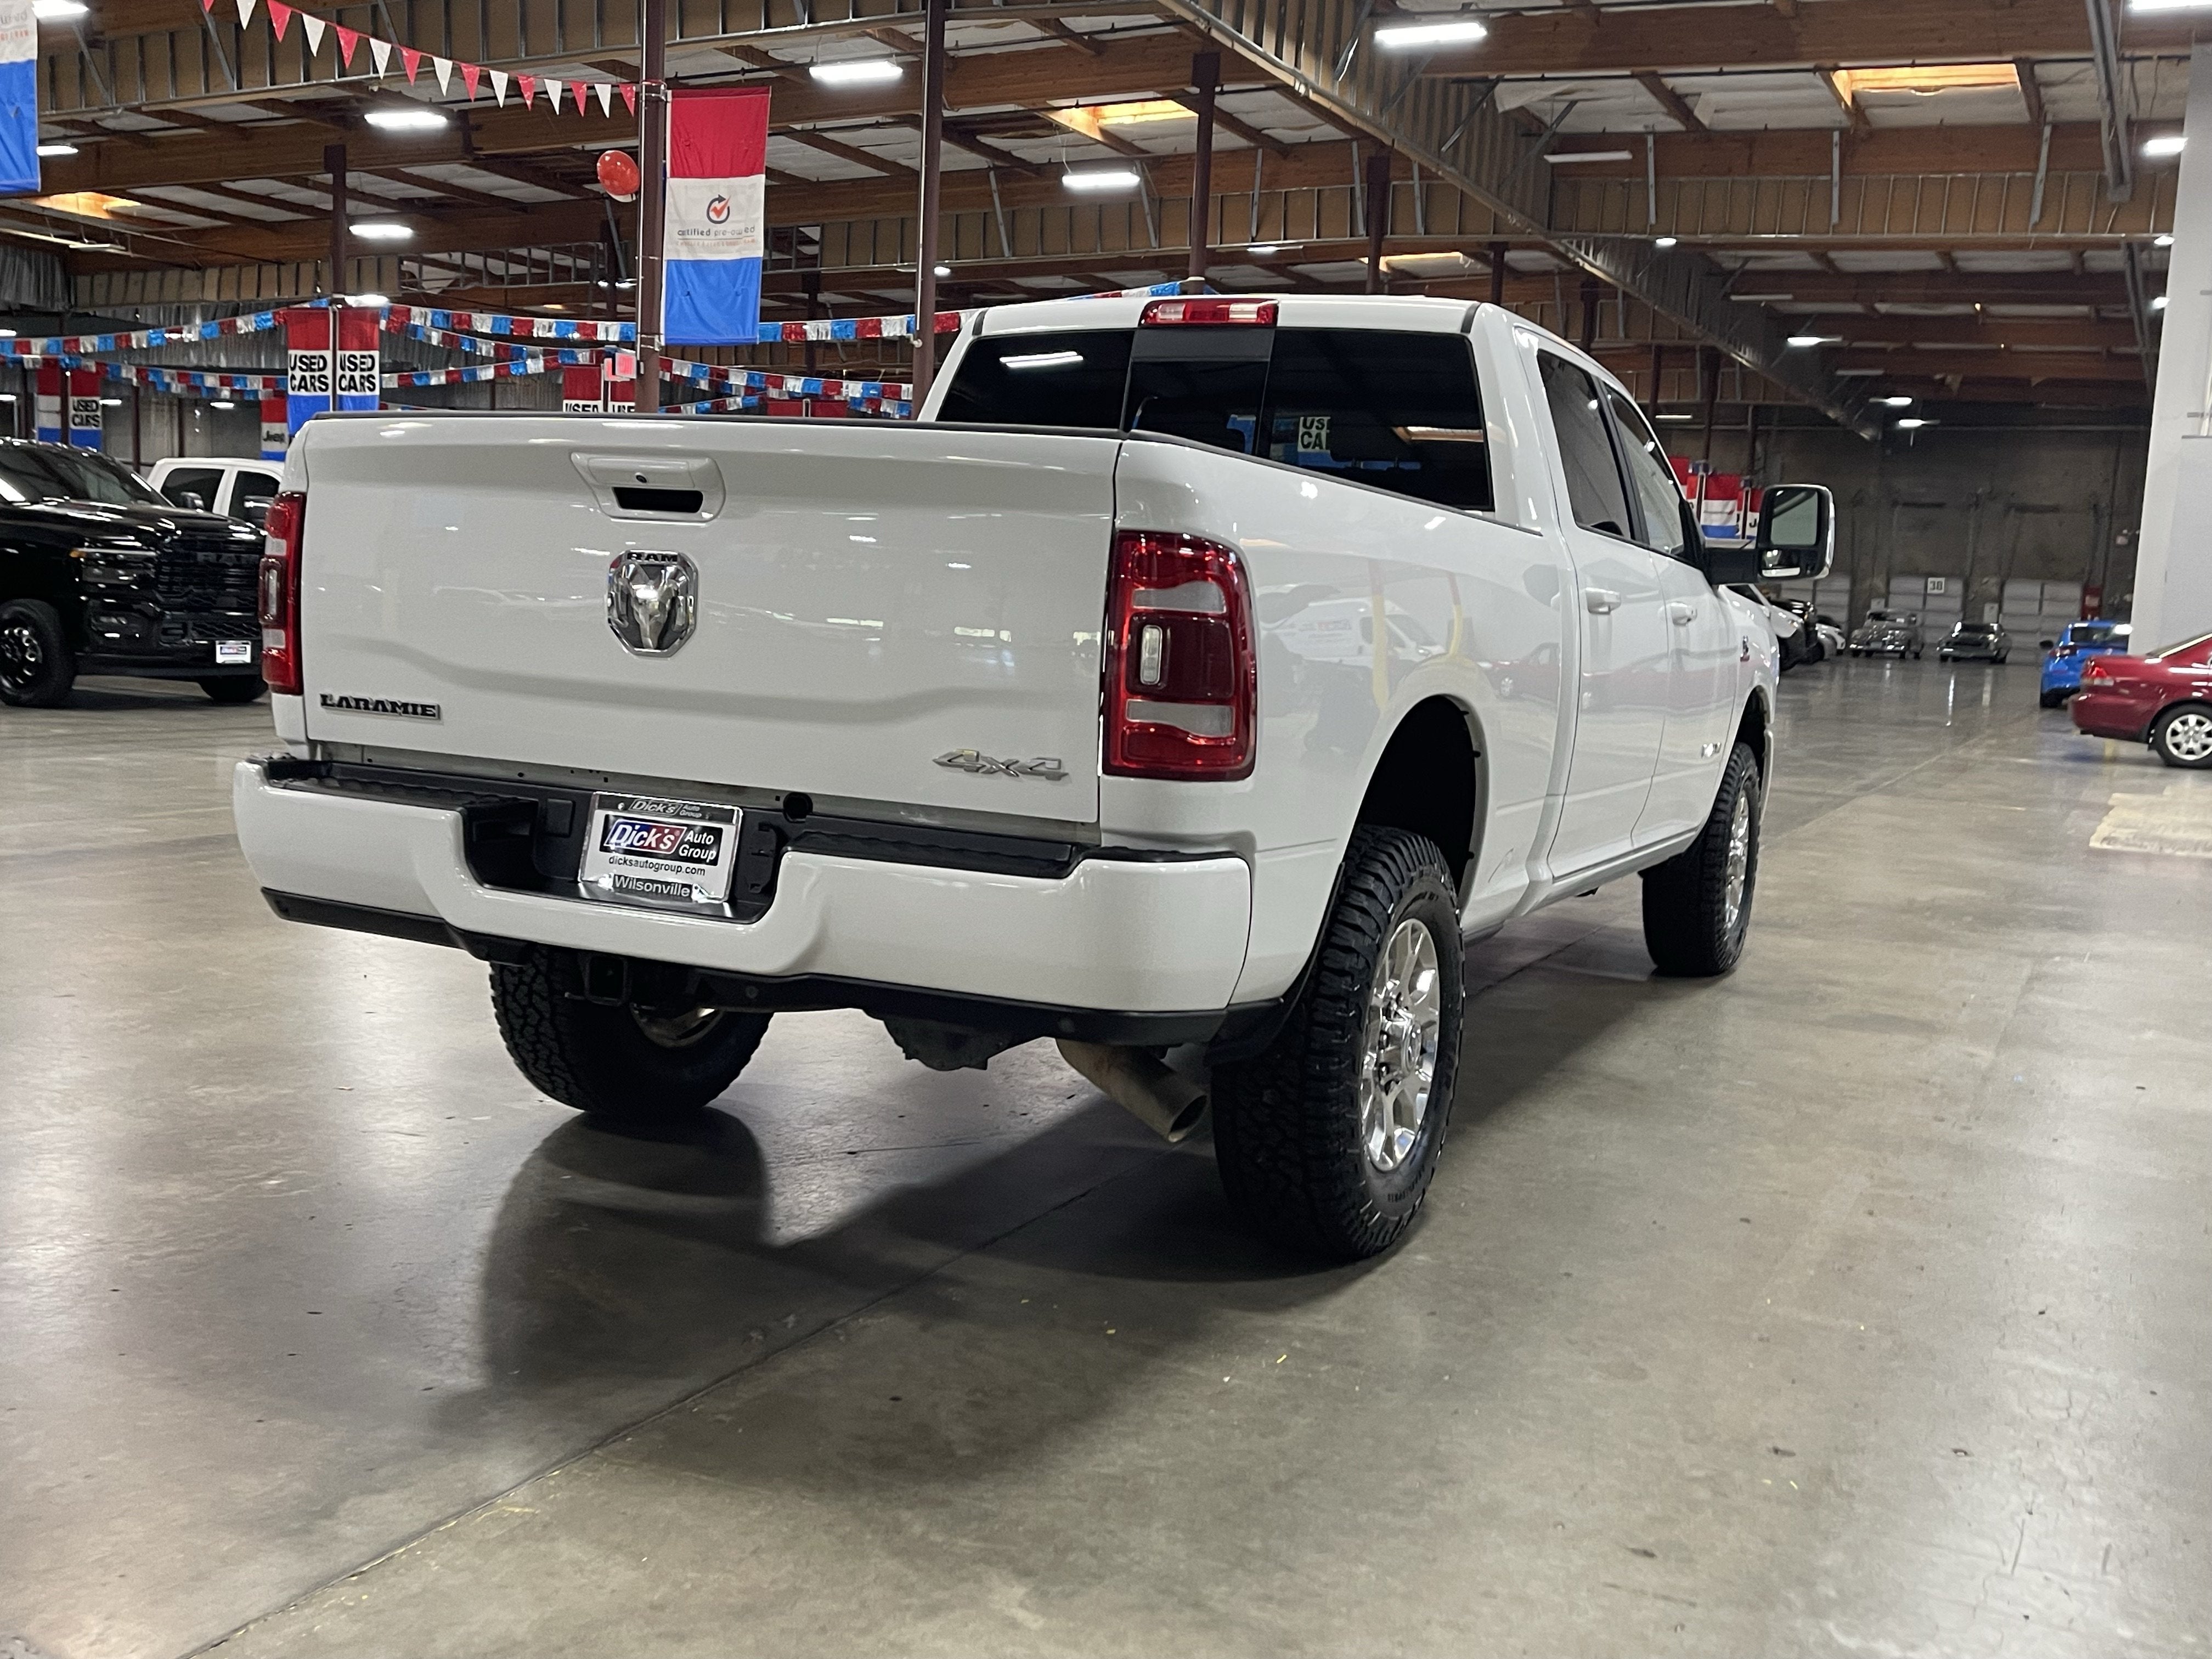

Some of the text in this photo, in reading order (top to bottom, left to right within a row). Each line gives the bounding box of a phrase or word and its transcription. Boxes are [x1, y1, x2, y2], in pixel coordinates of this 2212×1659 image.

[289, 354, 328, 372] USED
[340, 354, 375, 372] USED
[289, 374, 329, 392] CARS
[338, 374, 376, 392] CARS
[627, 552, 678, 562] RAM
[319, 693, 439, 719] LARAMIE
[632, 800, 676, 814] Dick's
[679, 809, 702, 819] Group
[611, 824, 715, 850] Dick's Auto
[679, 844, 717, 863] Group
[608, 855, 706, 876] dicksautogroup.com
[614, 874, 691, 898] Wilsonville
